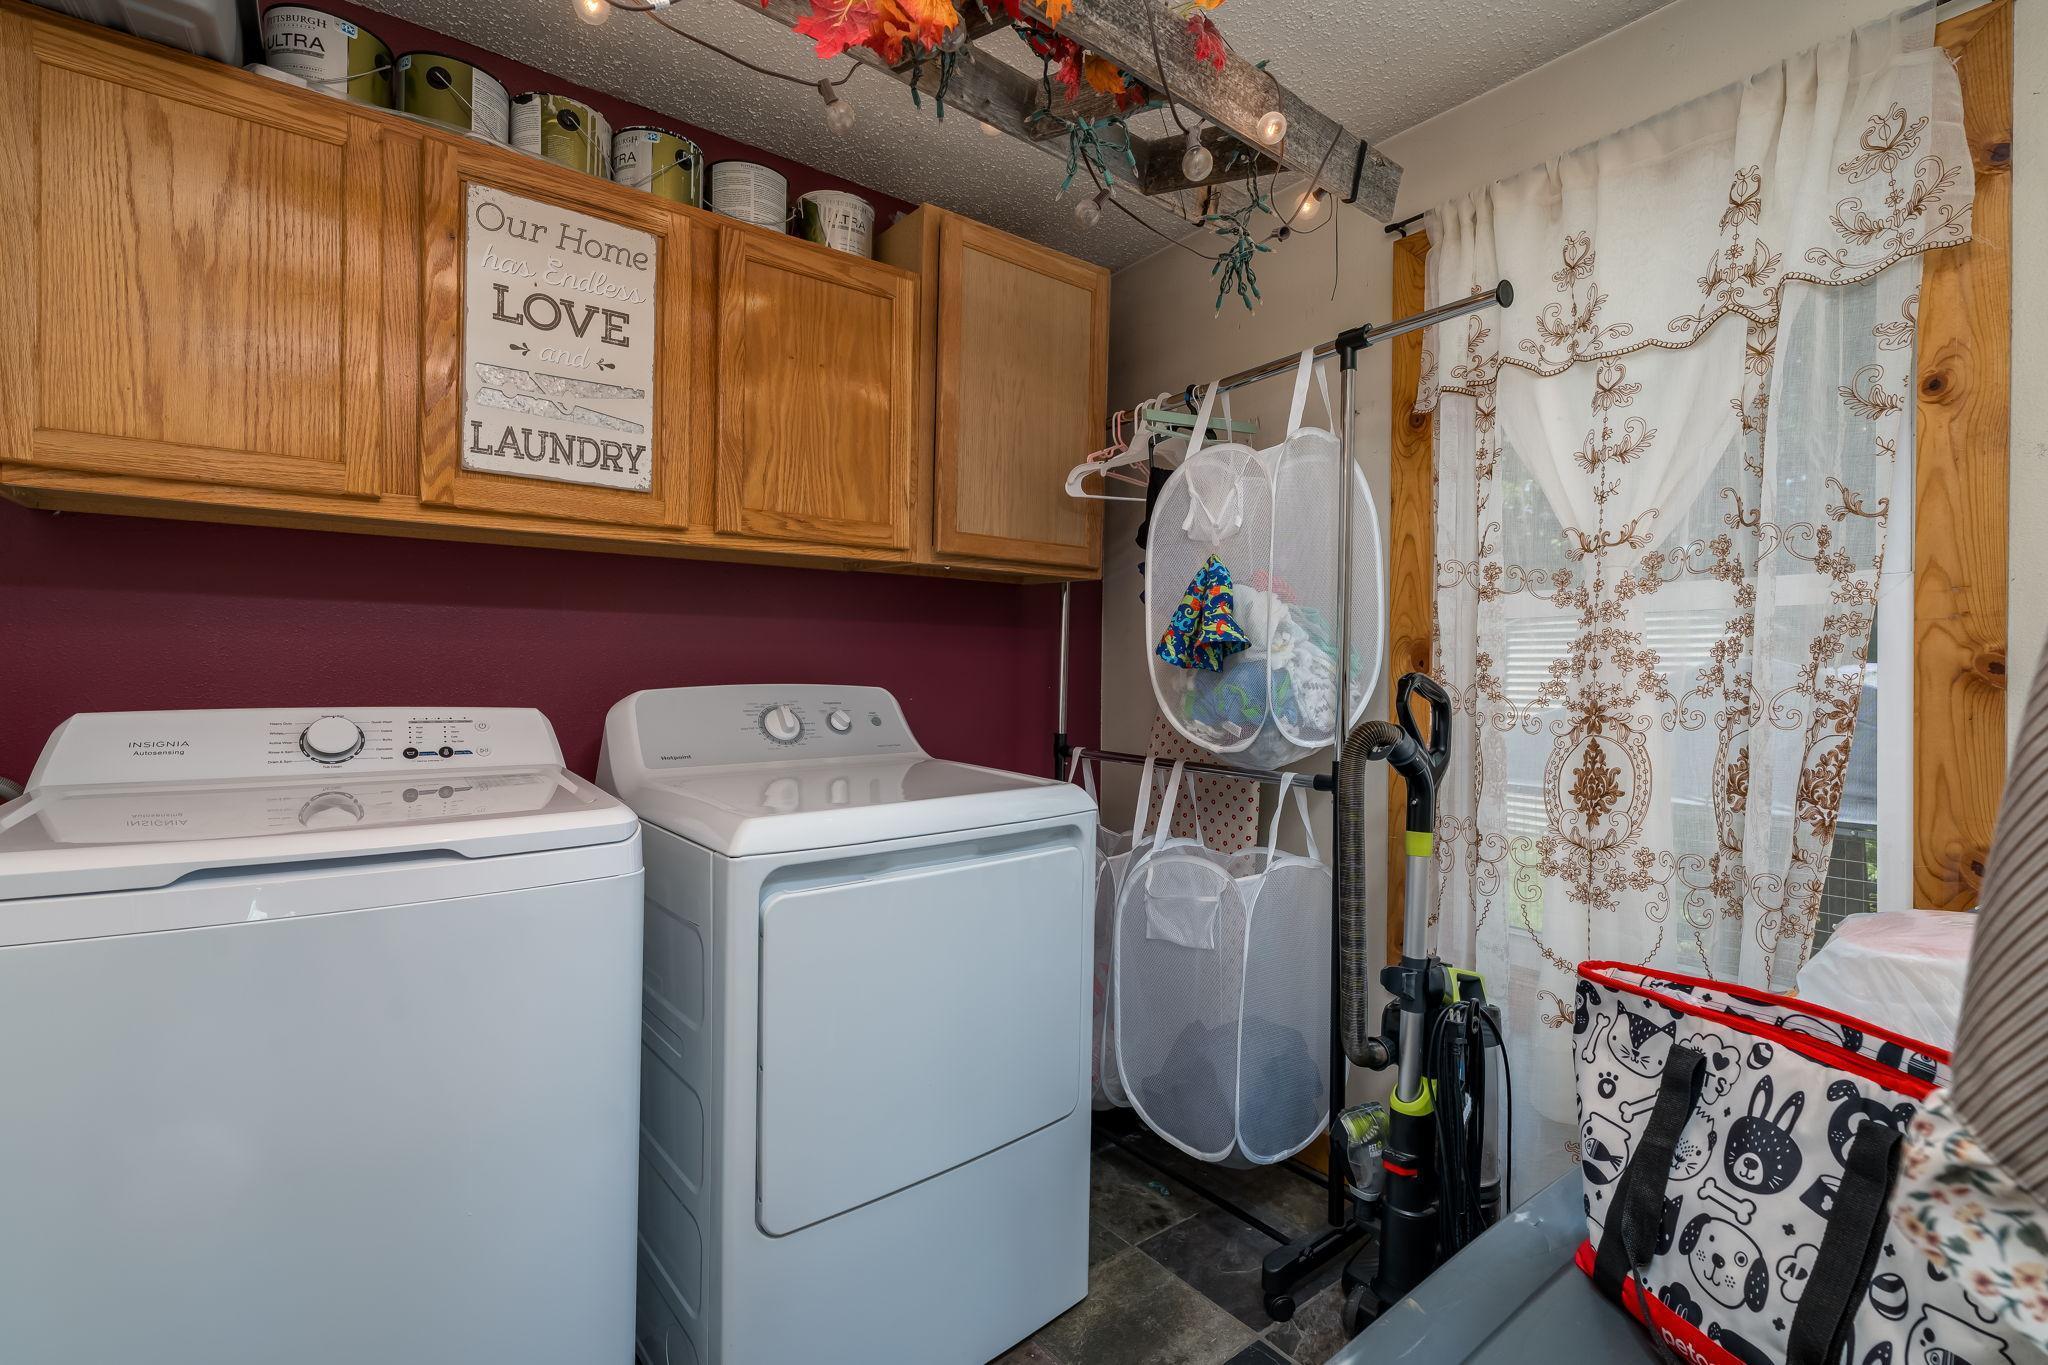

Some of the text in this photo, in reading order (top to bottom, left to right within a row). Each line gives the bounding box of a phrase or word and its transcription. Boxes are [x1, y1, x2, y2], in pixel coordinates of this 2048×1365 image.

[267, 33, 325, 52] ULTRA
[475, 202, 649, 271] Our Home
[482, 244, 647, 304] has Endless
[492, 282, 630, 348] LOVE
[539, 346, 593, 369] and
[470, 420, 647, 475] LAUNDRY
